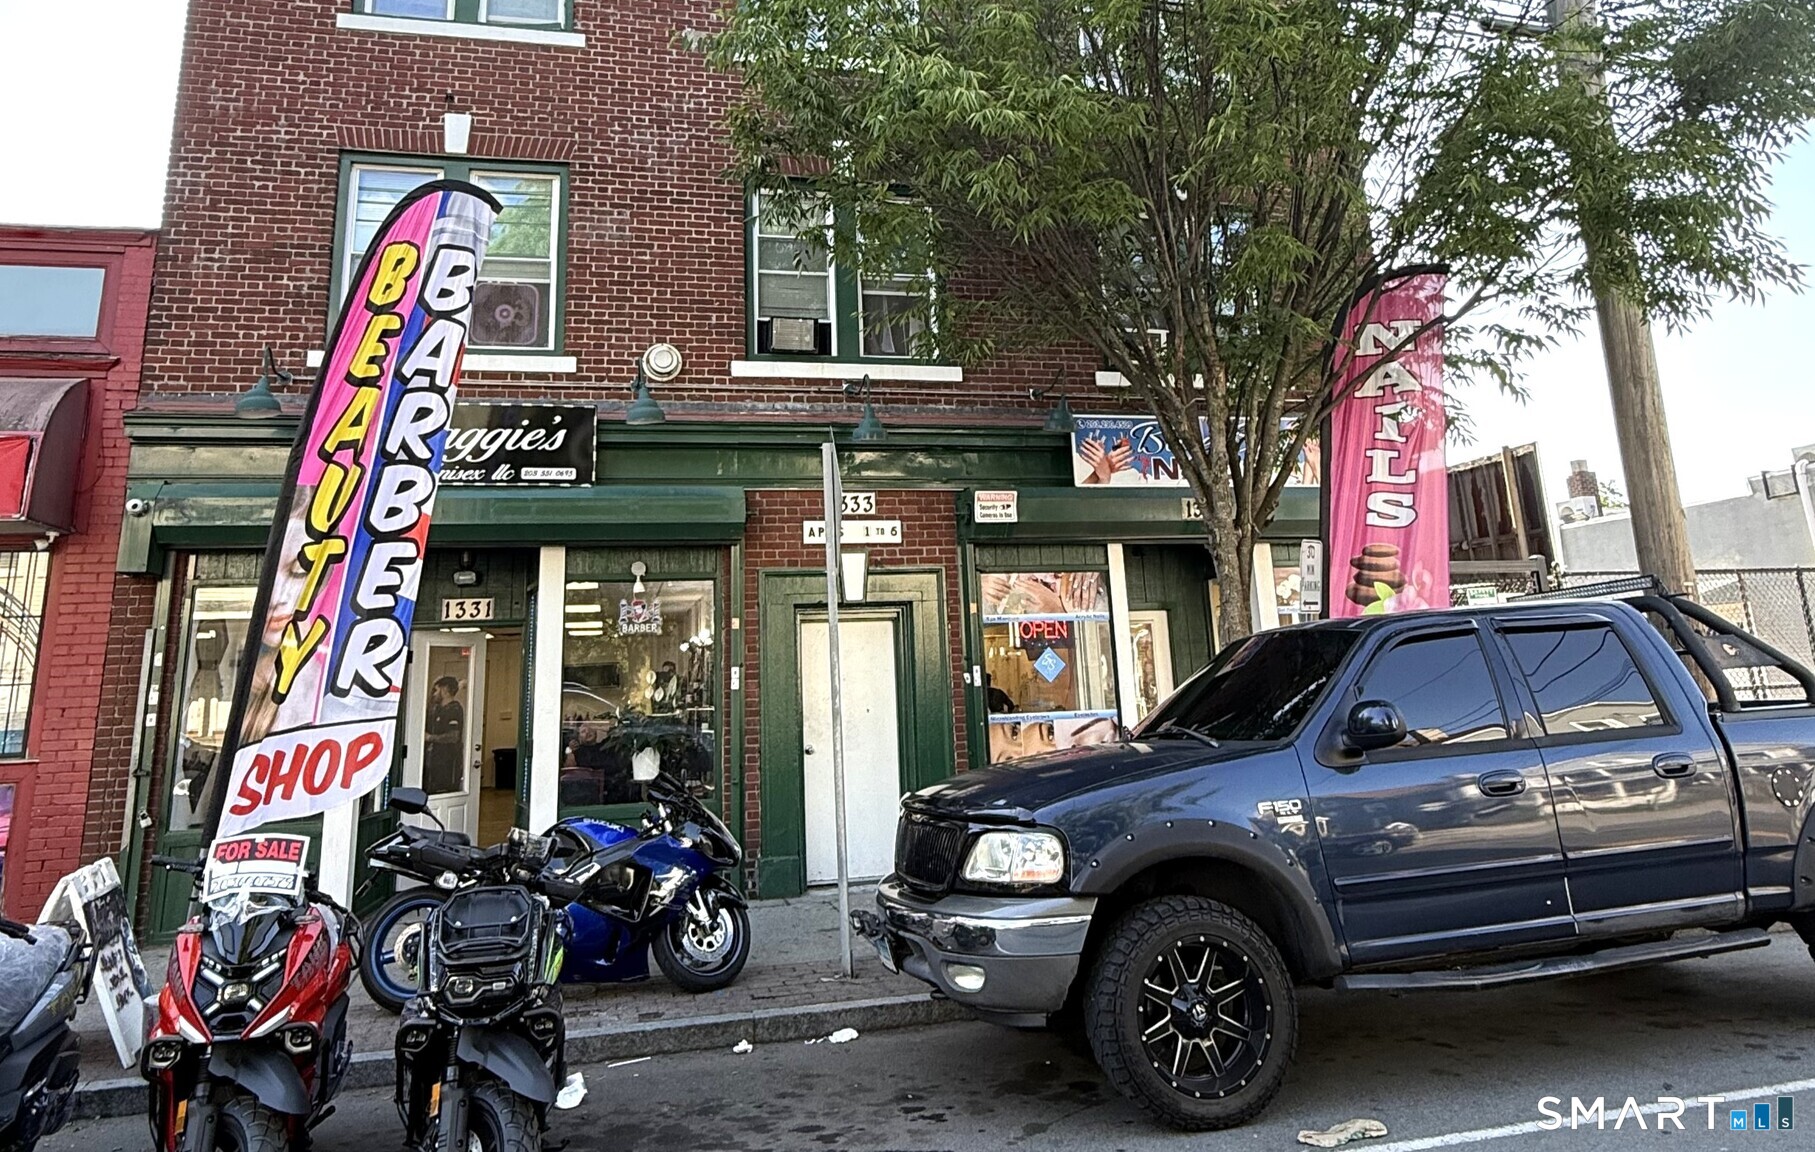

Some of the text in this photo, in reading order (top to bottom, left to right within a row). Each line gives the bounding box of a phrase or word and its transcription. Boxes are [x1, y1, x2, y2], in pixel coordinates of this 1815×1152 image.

[1353, 319, 1422, 529] NAILS
[442, 415, 567, 462] aggie's
[271, 241, 420, 705] BEAUTY
[330, 244, 477, 698] BARBER
[440, 463, 515, 480] nisex llc
[841, 495, 873, 513] 333
[979, 493, 1013, 501] WARNING
[865, 526, 870, 536] 1
[876, 528, 885, 536] TO
[890, 526, 898, 536] 6
[444, 600, 492, 620] 1331
[622, 623, 657, 633] BARBER
[1020, 620, 1068, 639] OPEN
[229, 732, 384, 816] SHOP
[1257, 799, 1303, 815] F150
[583, 818, 624, 833] SUZUKI
[214, 840, 302, 862] FOR SALE
